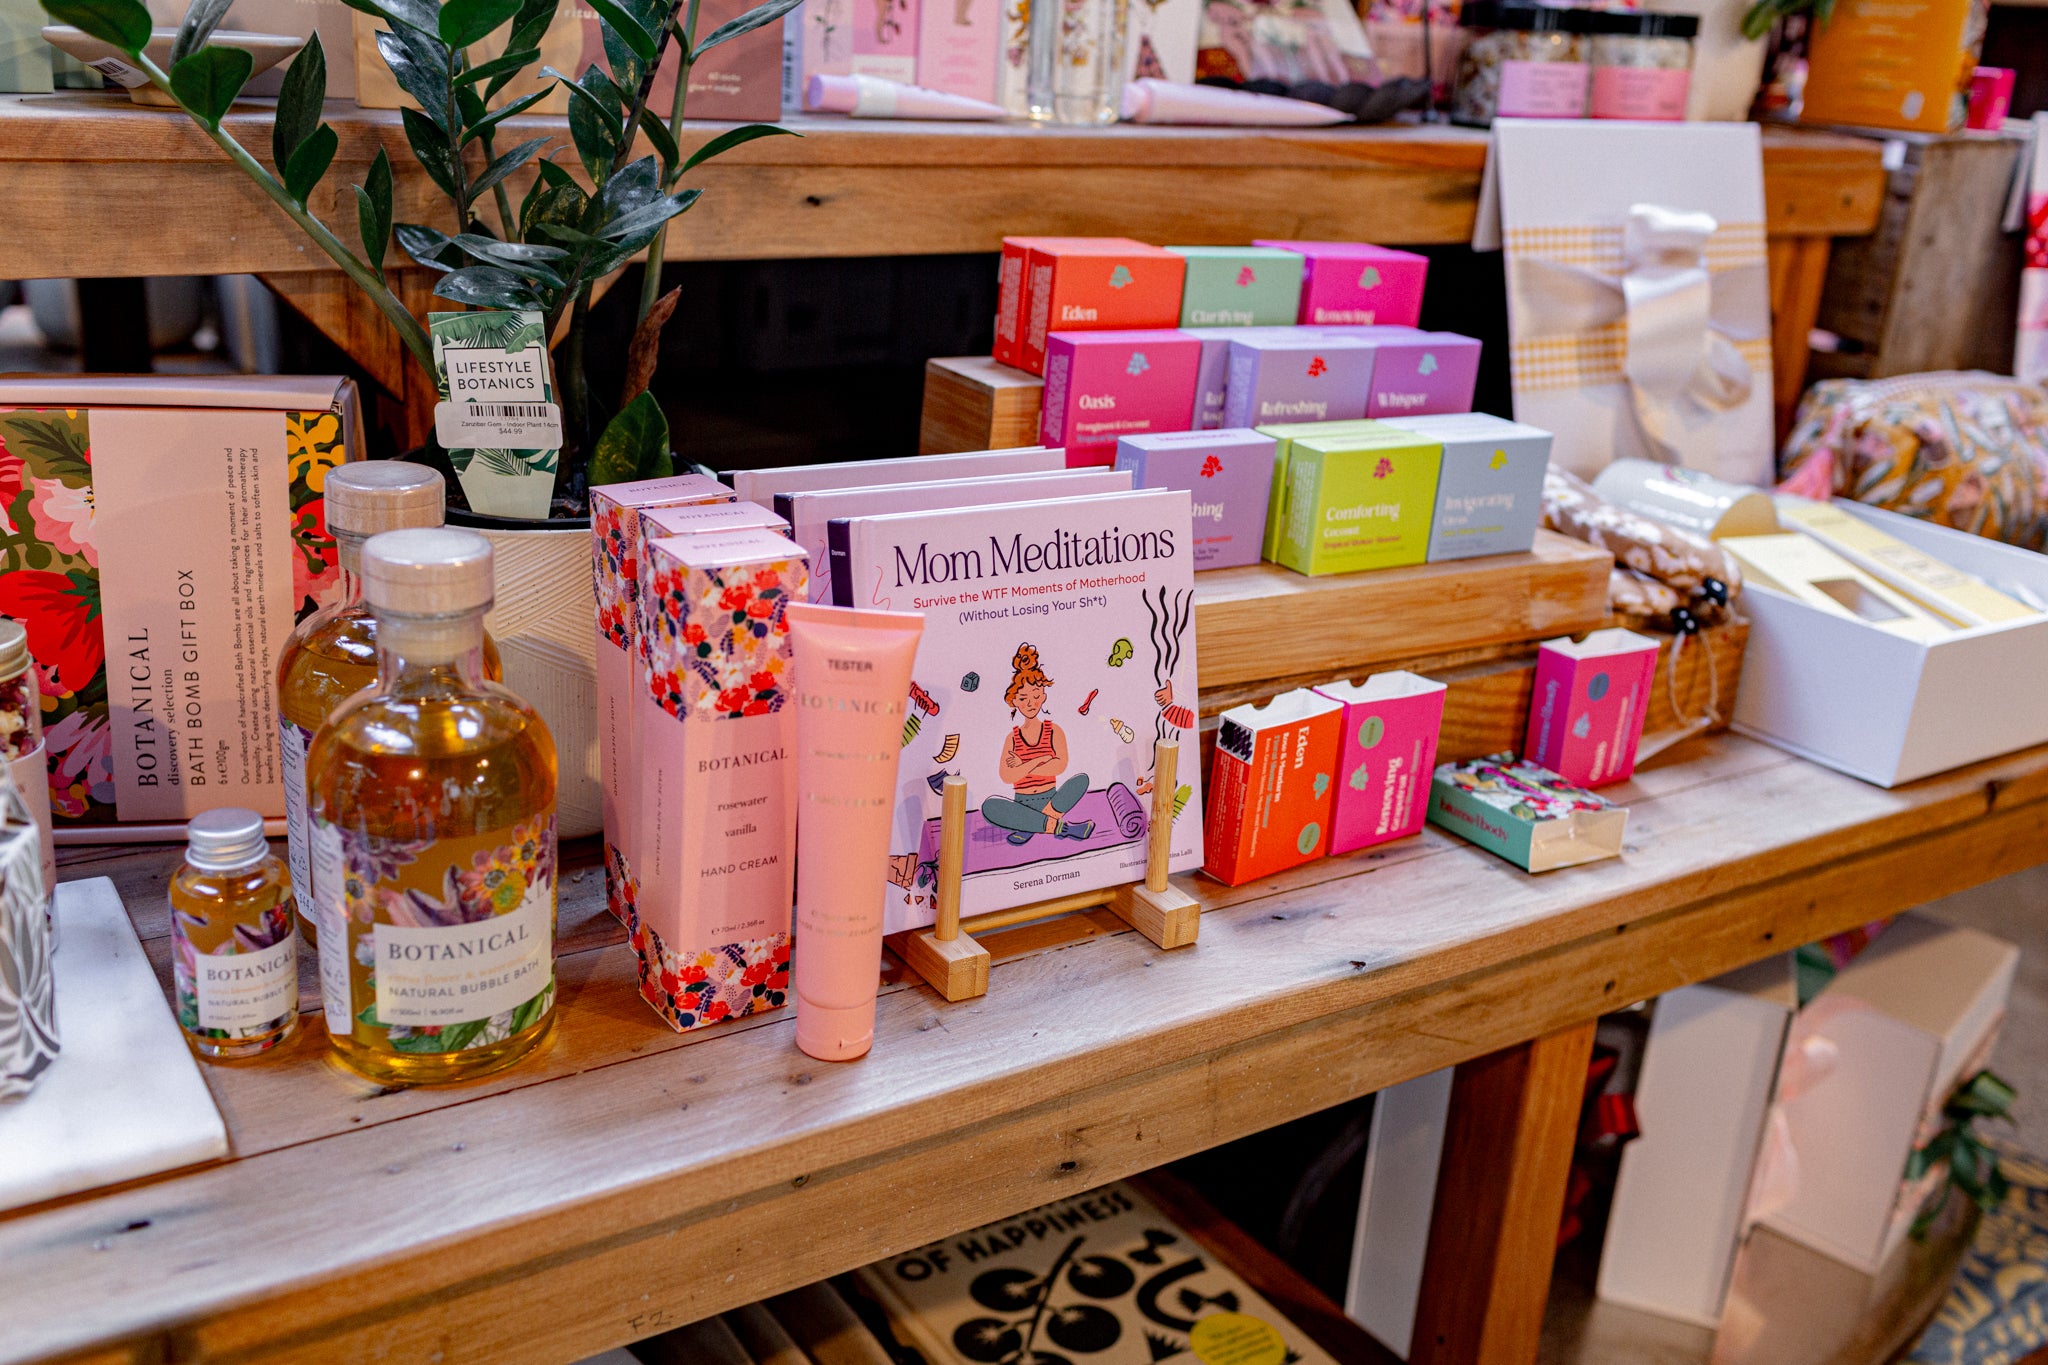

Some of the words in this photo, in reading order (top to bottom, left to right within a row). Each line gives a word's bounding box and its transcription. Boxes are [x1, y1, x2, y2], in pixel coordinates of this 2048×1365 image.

[1061, 305, 1098, 321] Eden
[1191, 309, 1253, 326] Clarifying
[1314, 307, 1376, 326] Renewing
[456, 362, 532, 373] LIFESTYLE
[458, 378, 534, 389] BOTANICS
[1079, 394, 1116, 409] Oasis
[1260, 400, 1327, 420] Refreshing
[1378, 392, 1428, 408] Whisper
[224, 448, 233, 462] and
[250, 448, 258, 462] and
[226, 465, 236, 488] peace
[238, 448, 248, 503] aromatherapy
[251, 466, 259, 480] skin
[226, 491, 234, 500] of
[252, 484, 260, 508] soften
[629, 482, 696, 493] BOTANICAL
[228, 502, 236, 535] moment
[239, 506, 249, 525] their
[679, 511, 746, 520] BOTANICAL
[1326, 502, 1400, 522] Comforting
[241, 529, 249, 540] for
[253, 523, 262, 540] salts
[1323, 525, 1360, 539] Coconut
[230, 546, 240, 569] taking
[254, 543, 263, 557] and
[893, 542, 984, 588] Mom
[989, 526, 1176, 578] Meditations
[242, 545, 254, 584] fragrances
[255, 560, 264, 592] minerals
[177, 569, 195, 610] BOX
[243, 588, 252, 602] and
[913, 594, 957, 610] Survive
[959, 592, 979, 604] the
[981, 588, 1008, 602] WTF
[1011, 582, 1064, 597] Moments
[1066, 579, 1077, 592] of
[1079, 572, 1146, 590] Motherhood
[232, 597, 240, 605] all
[257, 595, 266, 614] earth
[958, 608, 1009, 626] (Without
[1012, 602, 1049, 617] Losing
[1051, 599, 1077, 612] Your
[181, 619, 197, 662] GIFT
[233, 623, 242, 649] Bombs
[246, 622, 254, 655] essential
[258, 617, 267, 644] natural
[234, 652, 243, 670] Bath
[259, 647, 269, 668] clays,
[828, 659, 872, 672] TESTER
[248, 658, 257, 684] natural
[162, 669, 176, 724] selection
[184, 671, 202, 728] BOMB
[236, 673, 246, 718] handcrafted
[250, 688, 259, 707] using
[261, 670, 271, 711] detoxifying
[128, 628, 158, 788] BOTANICAL
[238, 719, 246, 728] of
[251, 711, 260, 741] Created
[263, 714, 271, 730] with
[240, 731, 249, 766] collection
[264, 732, 274, 752] along
[1293, 725, 1309, 769] Eden
[166, 728, 180, 786] discovery
[188, 738, 206, 785] BATH
[253, 745, 262, 784] tranquility.
[698, 748, 788, 773] BOTANICAL
[241, 769, 250, 784] Our
[265, 754, 274, 784] benefits
[717, 796, 768, 811] rosewater
[1375, 755, 1403, 835] Renewing
[724, 824, 757, 838] vanilla
[1181, 849, 1193, 857] Lalli
[701, 864, 735, 878] HAND
[739, 855, 778, 871] CREAM
[1013, 877, 1044, 891] Serena
[1045, 870, 1081, 884] Dorman
[388, 923, 530, 962] BOTANICAL
[388, 982, 455, 998] NATURAL
[460, 973, 509, 995] BUBBLE
[514, 959, 540, 980] BATH
[896, 1250, 952, 1282] OF
[956, 1190, 1136, 1264] HAPPINESS
